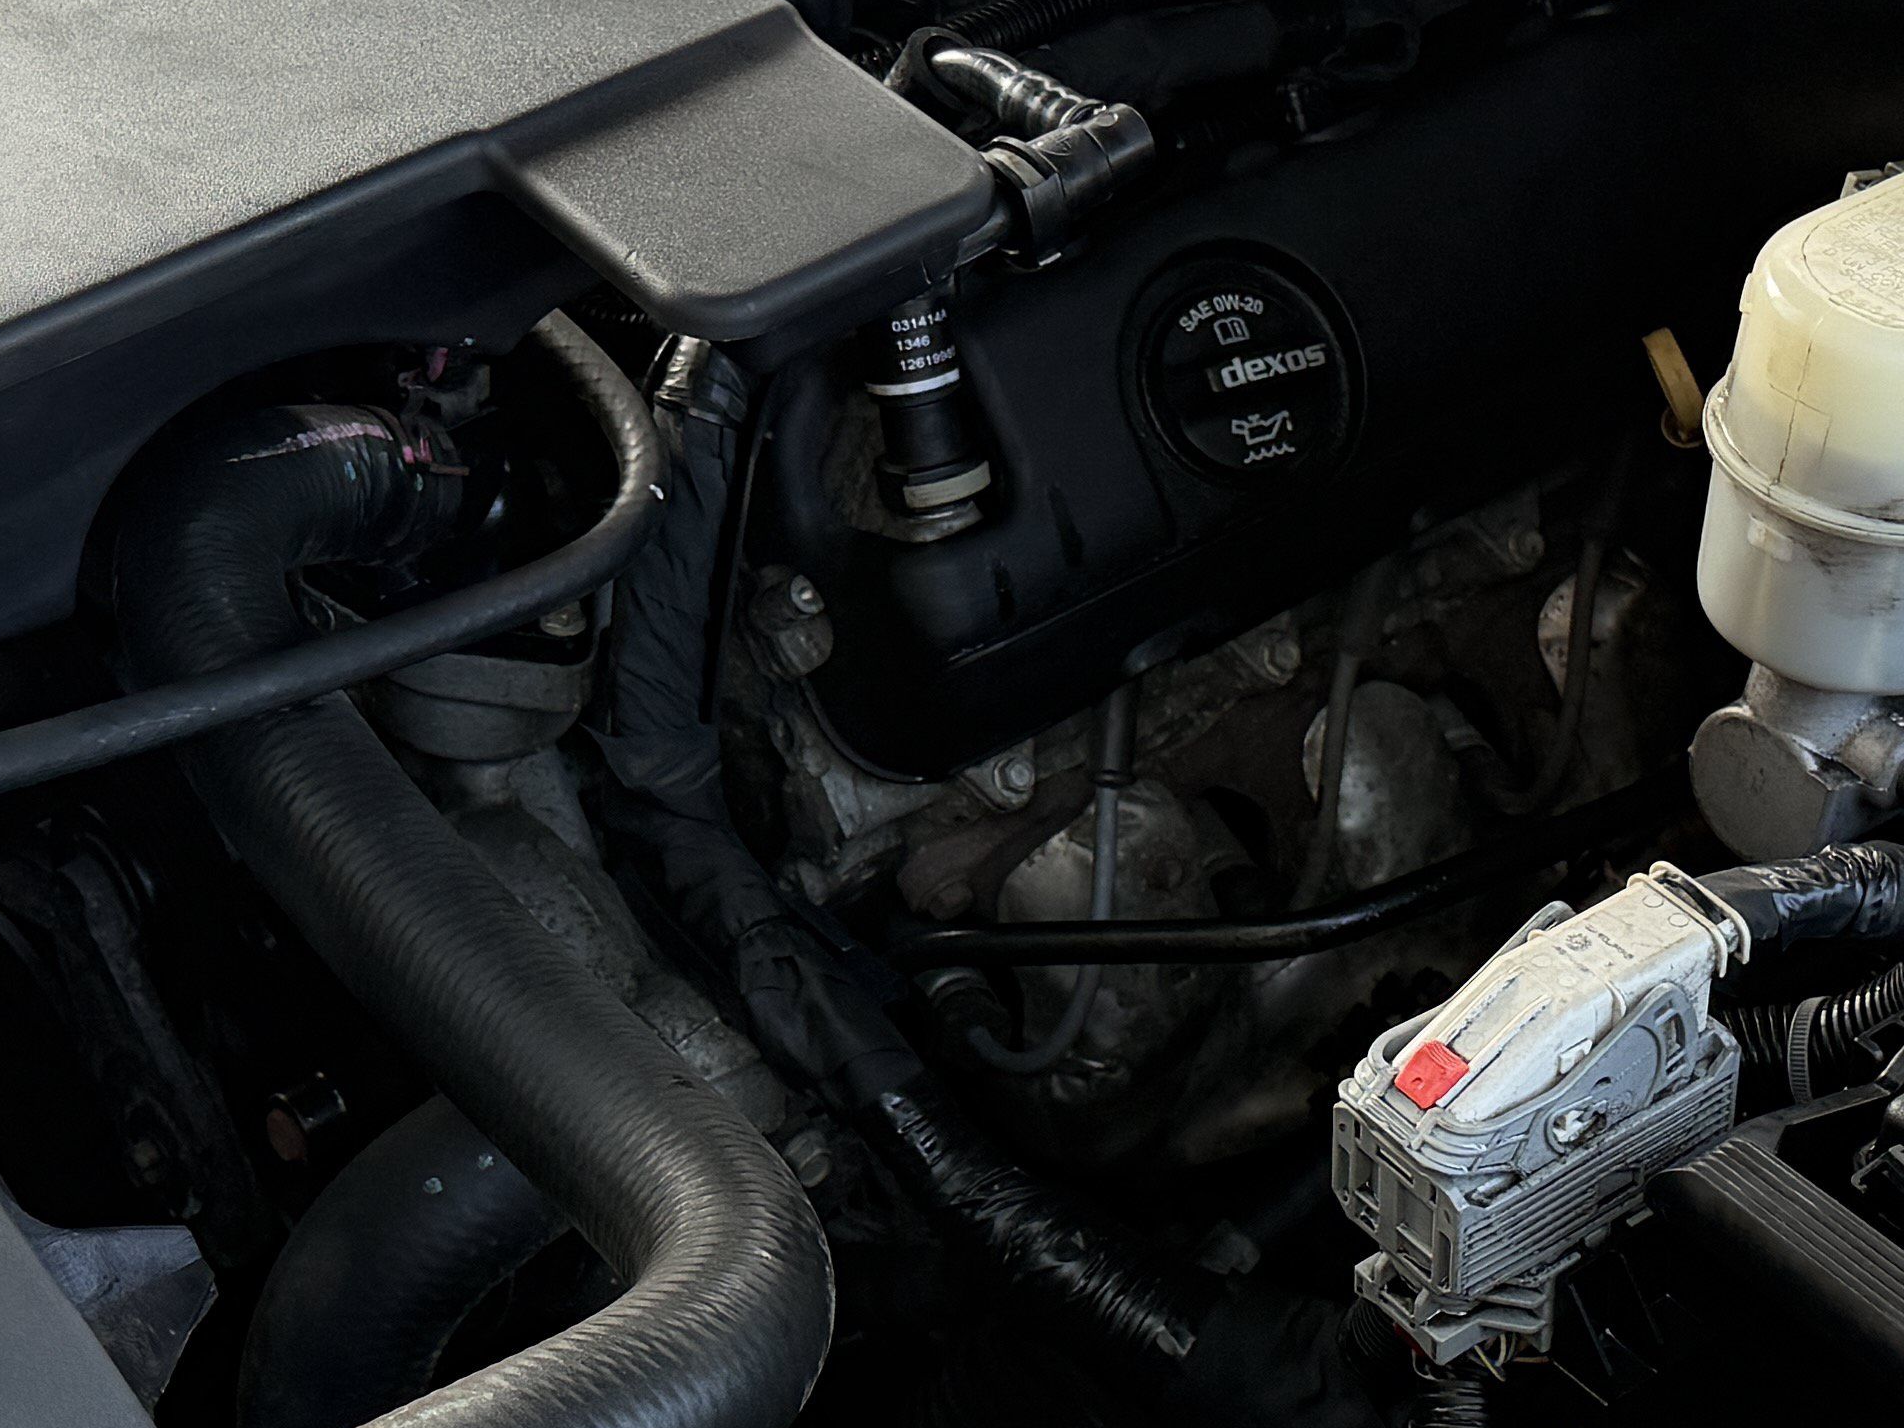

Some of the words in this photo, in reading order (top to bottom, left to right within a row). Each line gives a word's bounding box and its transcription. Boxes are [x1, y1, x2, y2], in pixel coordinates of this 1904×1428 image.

[1179, 300, 1214, 332] SAE
[1213, 294, 1264, 315] 0W-20
[897, 335, 931, 352] 1346
[1220, 343, 1327, 389] dexos
